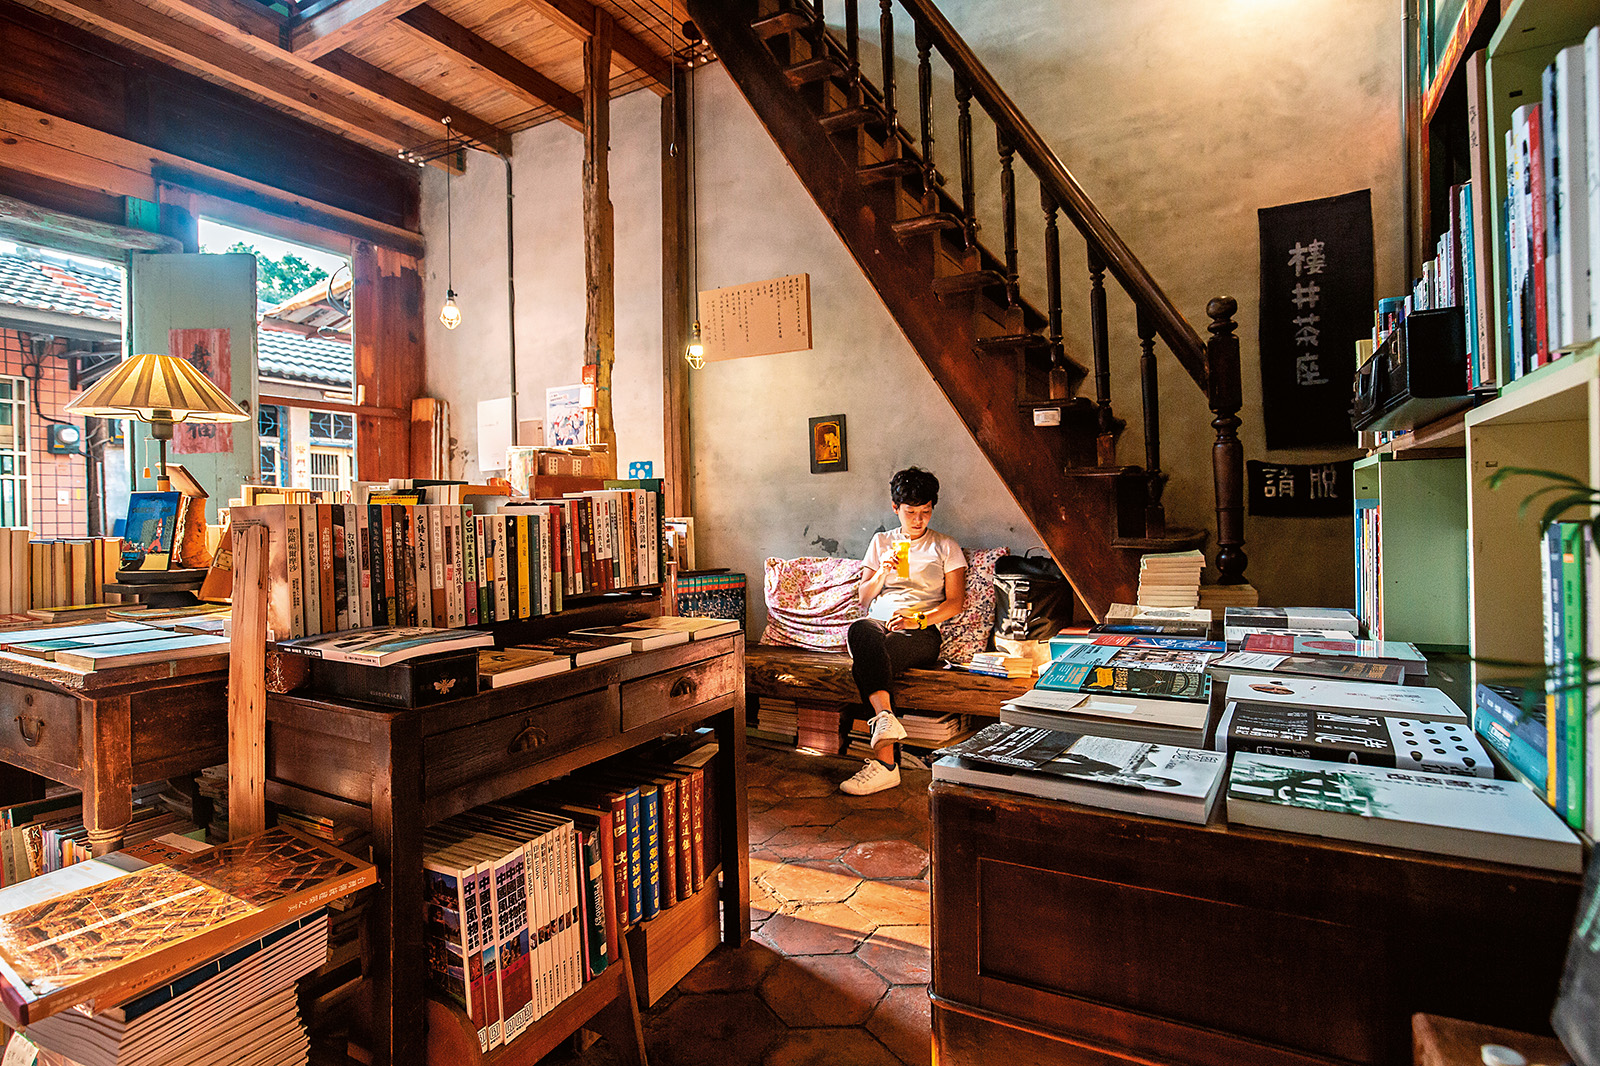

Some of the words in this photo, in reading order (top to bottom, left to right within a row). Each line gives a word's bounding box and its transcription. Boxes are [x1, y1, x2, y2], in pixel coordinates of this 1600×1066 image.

[1288, 239, 1328, 386] 樓井茶座
[1262, 464, 1338, 500] 請脫
